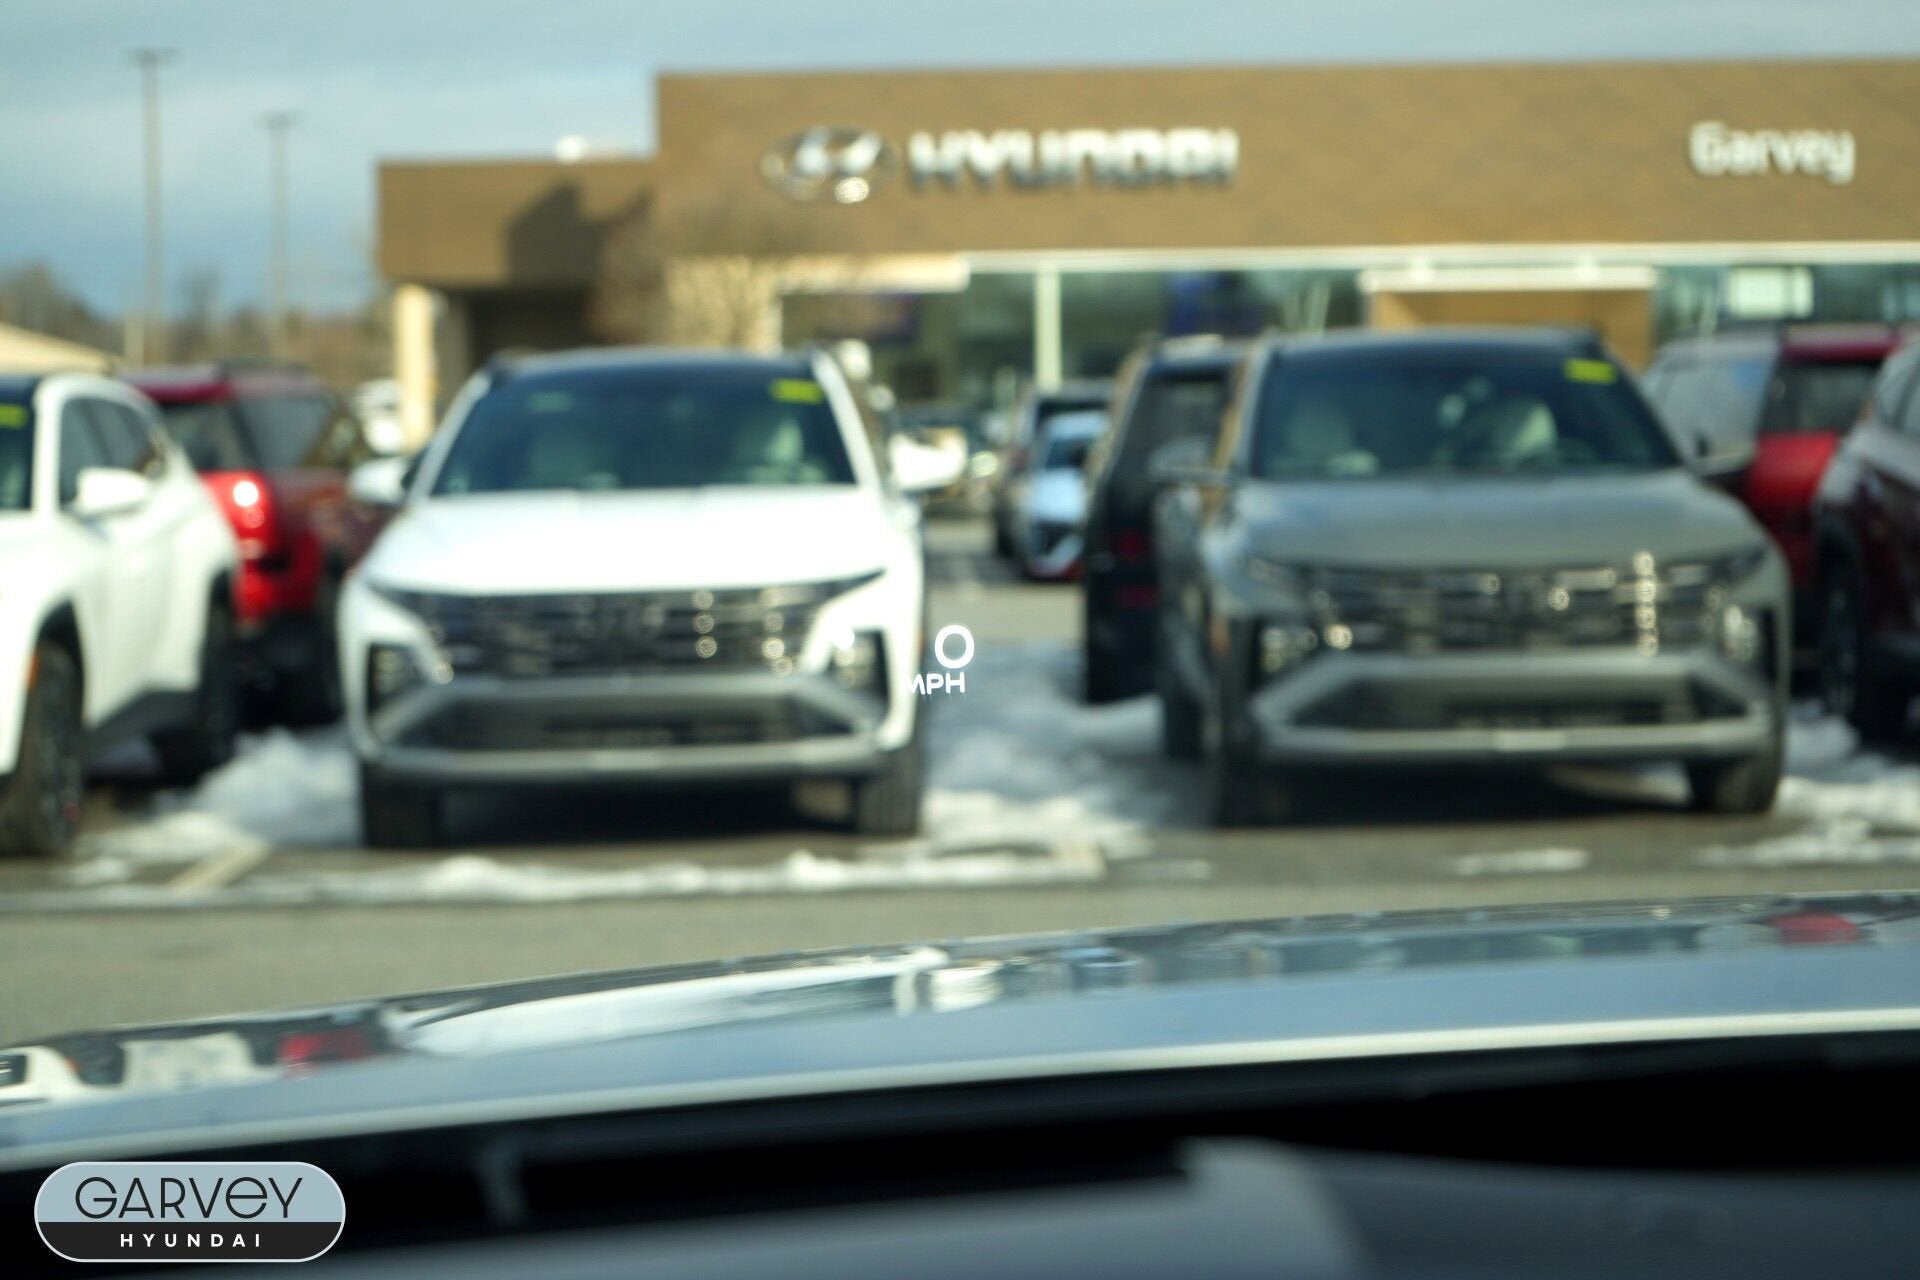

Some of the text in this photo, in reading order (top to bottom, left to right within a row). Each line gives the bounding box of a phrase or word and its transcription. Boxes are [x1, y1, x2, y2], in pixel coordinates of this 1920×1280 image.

[907, 127, 1239, 187] HYUNDAI
[1690, 121, 1855, 185] Garvey
[904, 671, 965, 695] MPH
